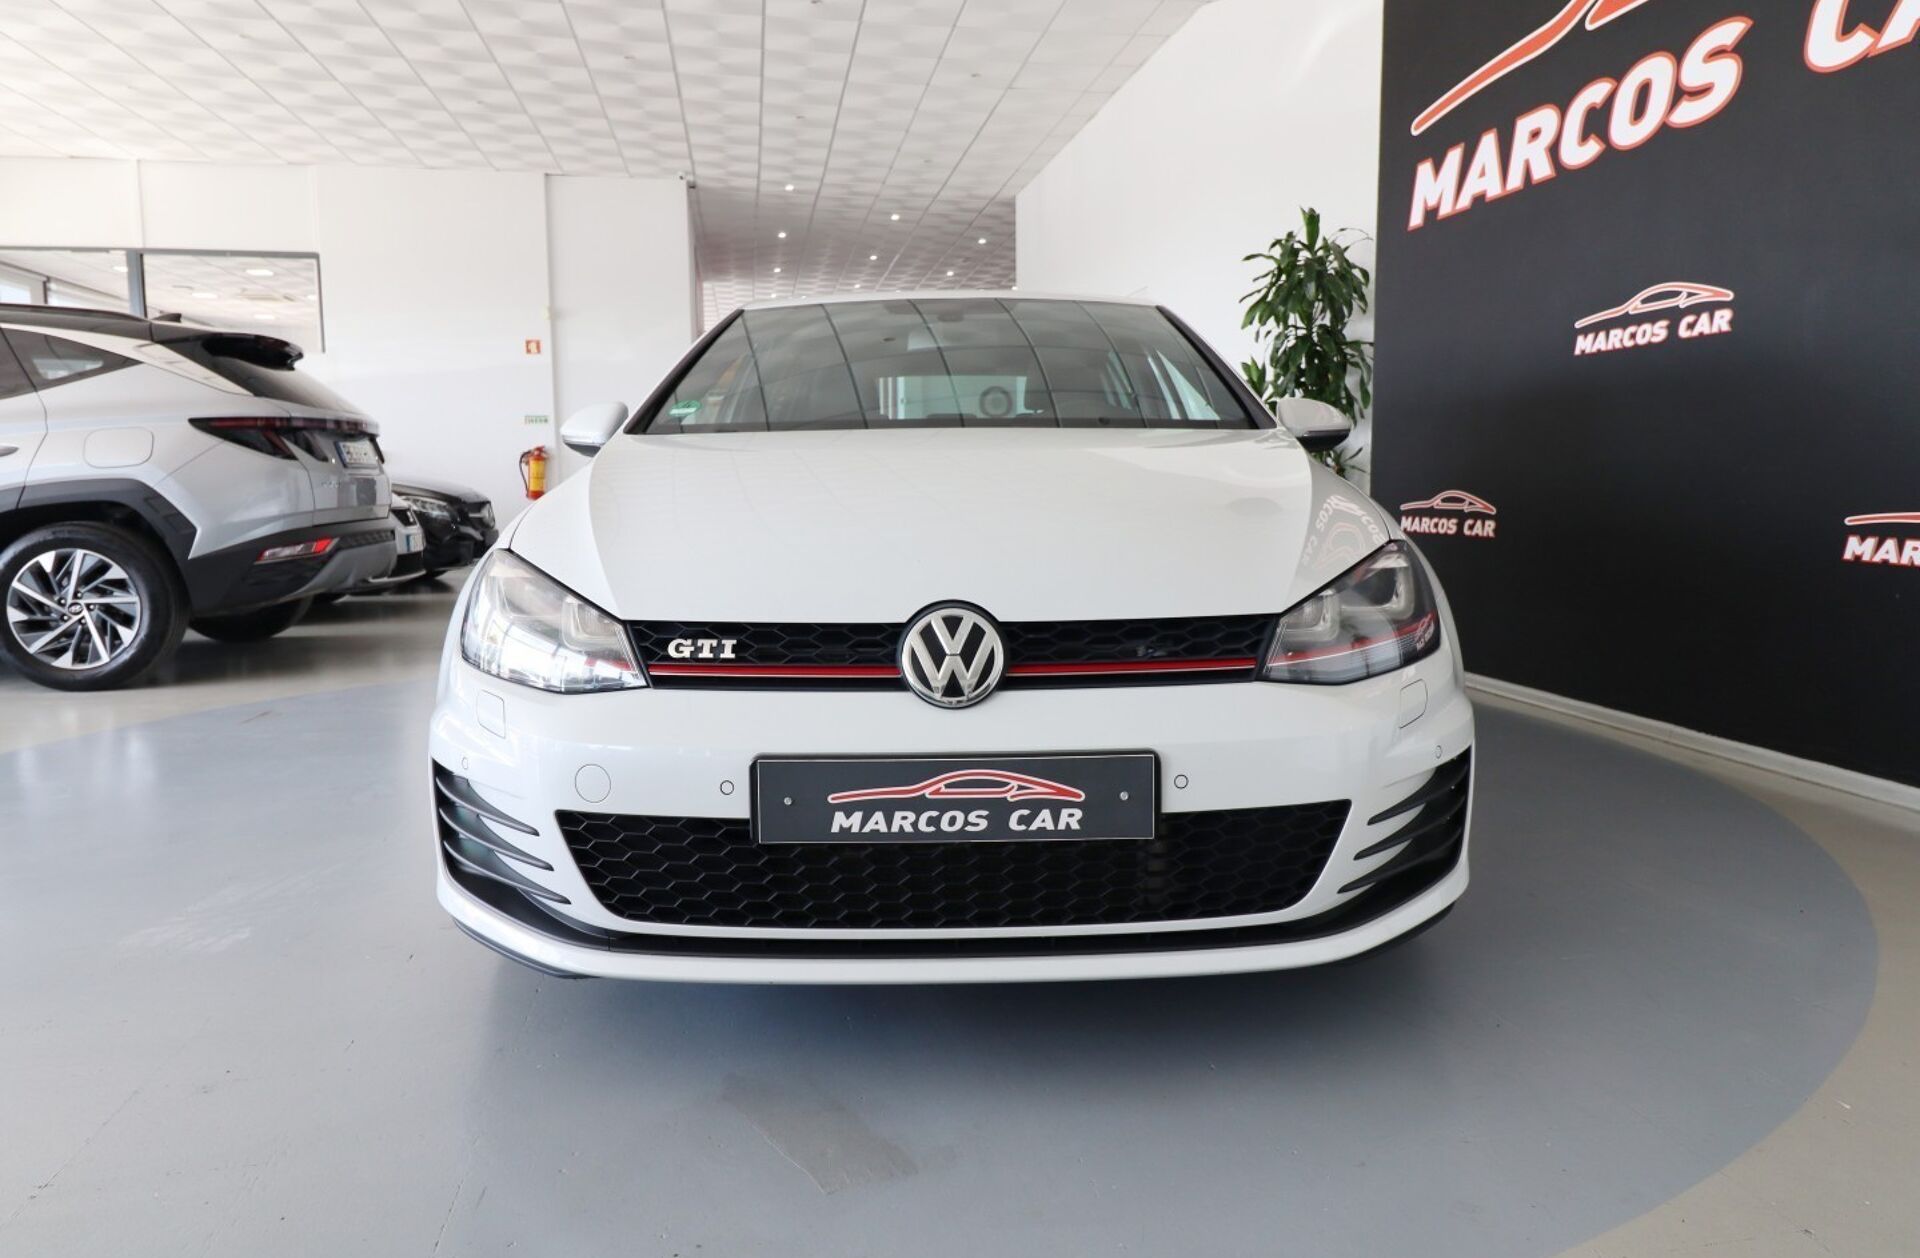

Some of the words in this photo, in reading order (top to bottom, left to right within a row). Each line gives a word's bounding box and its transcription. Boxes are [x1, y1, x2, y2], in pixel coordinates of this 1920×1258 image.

[1407, 16, 1753, 231] MARCOS
[1574, 320, 1670, 356] MARCOS
[1677, 308, 1733, 338] CAR
[1400, 515, 1458, 535] MARCOS
[1463, 518, 1496, 537] CAR
[667, 638, 737, 659] GTI
[830, 810, 990, 833] MARCOS
[1008, 808, 1083, 831] CAR
